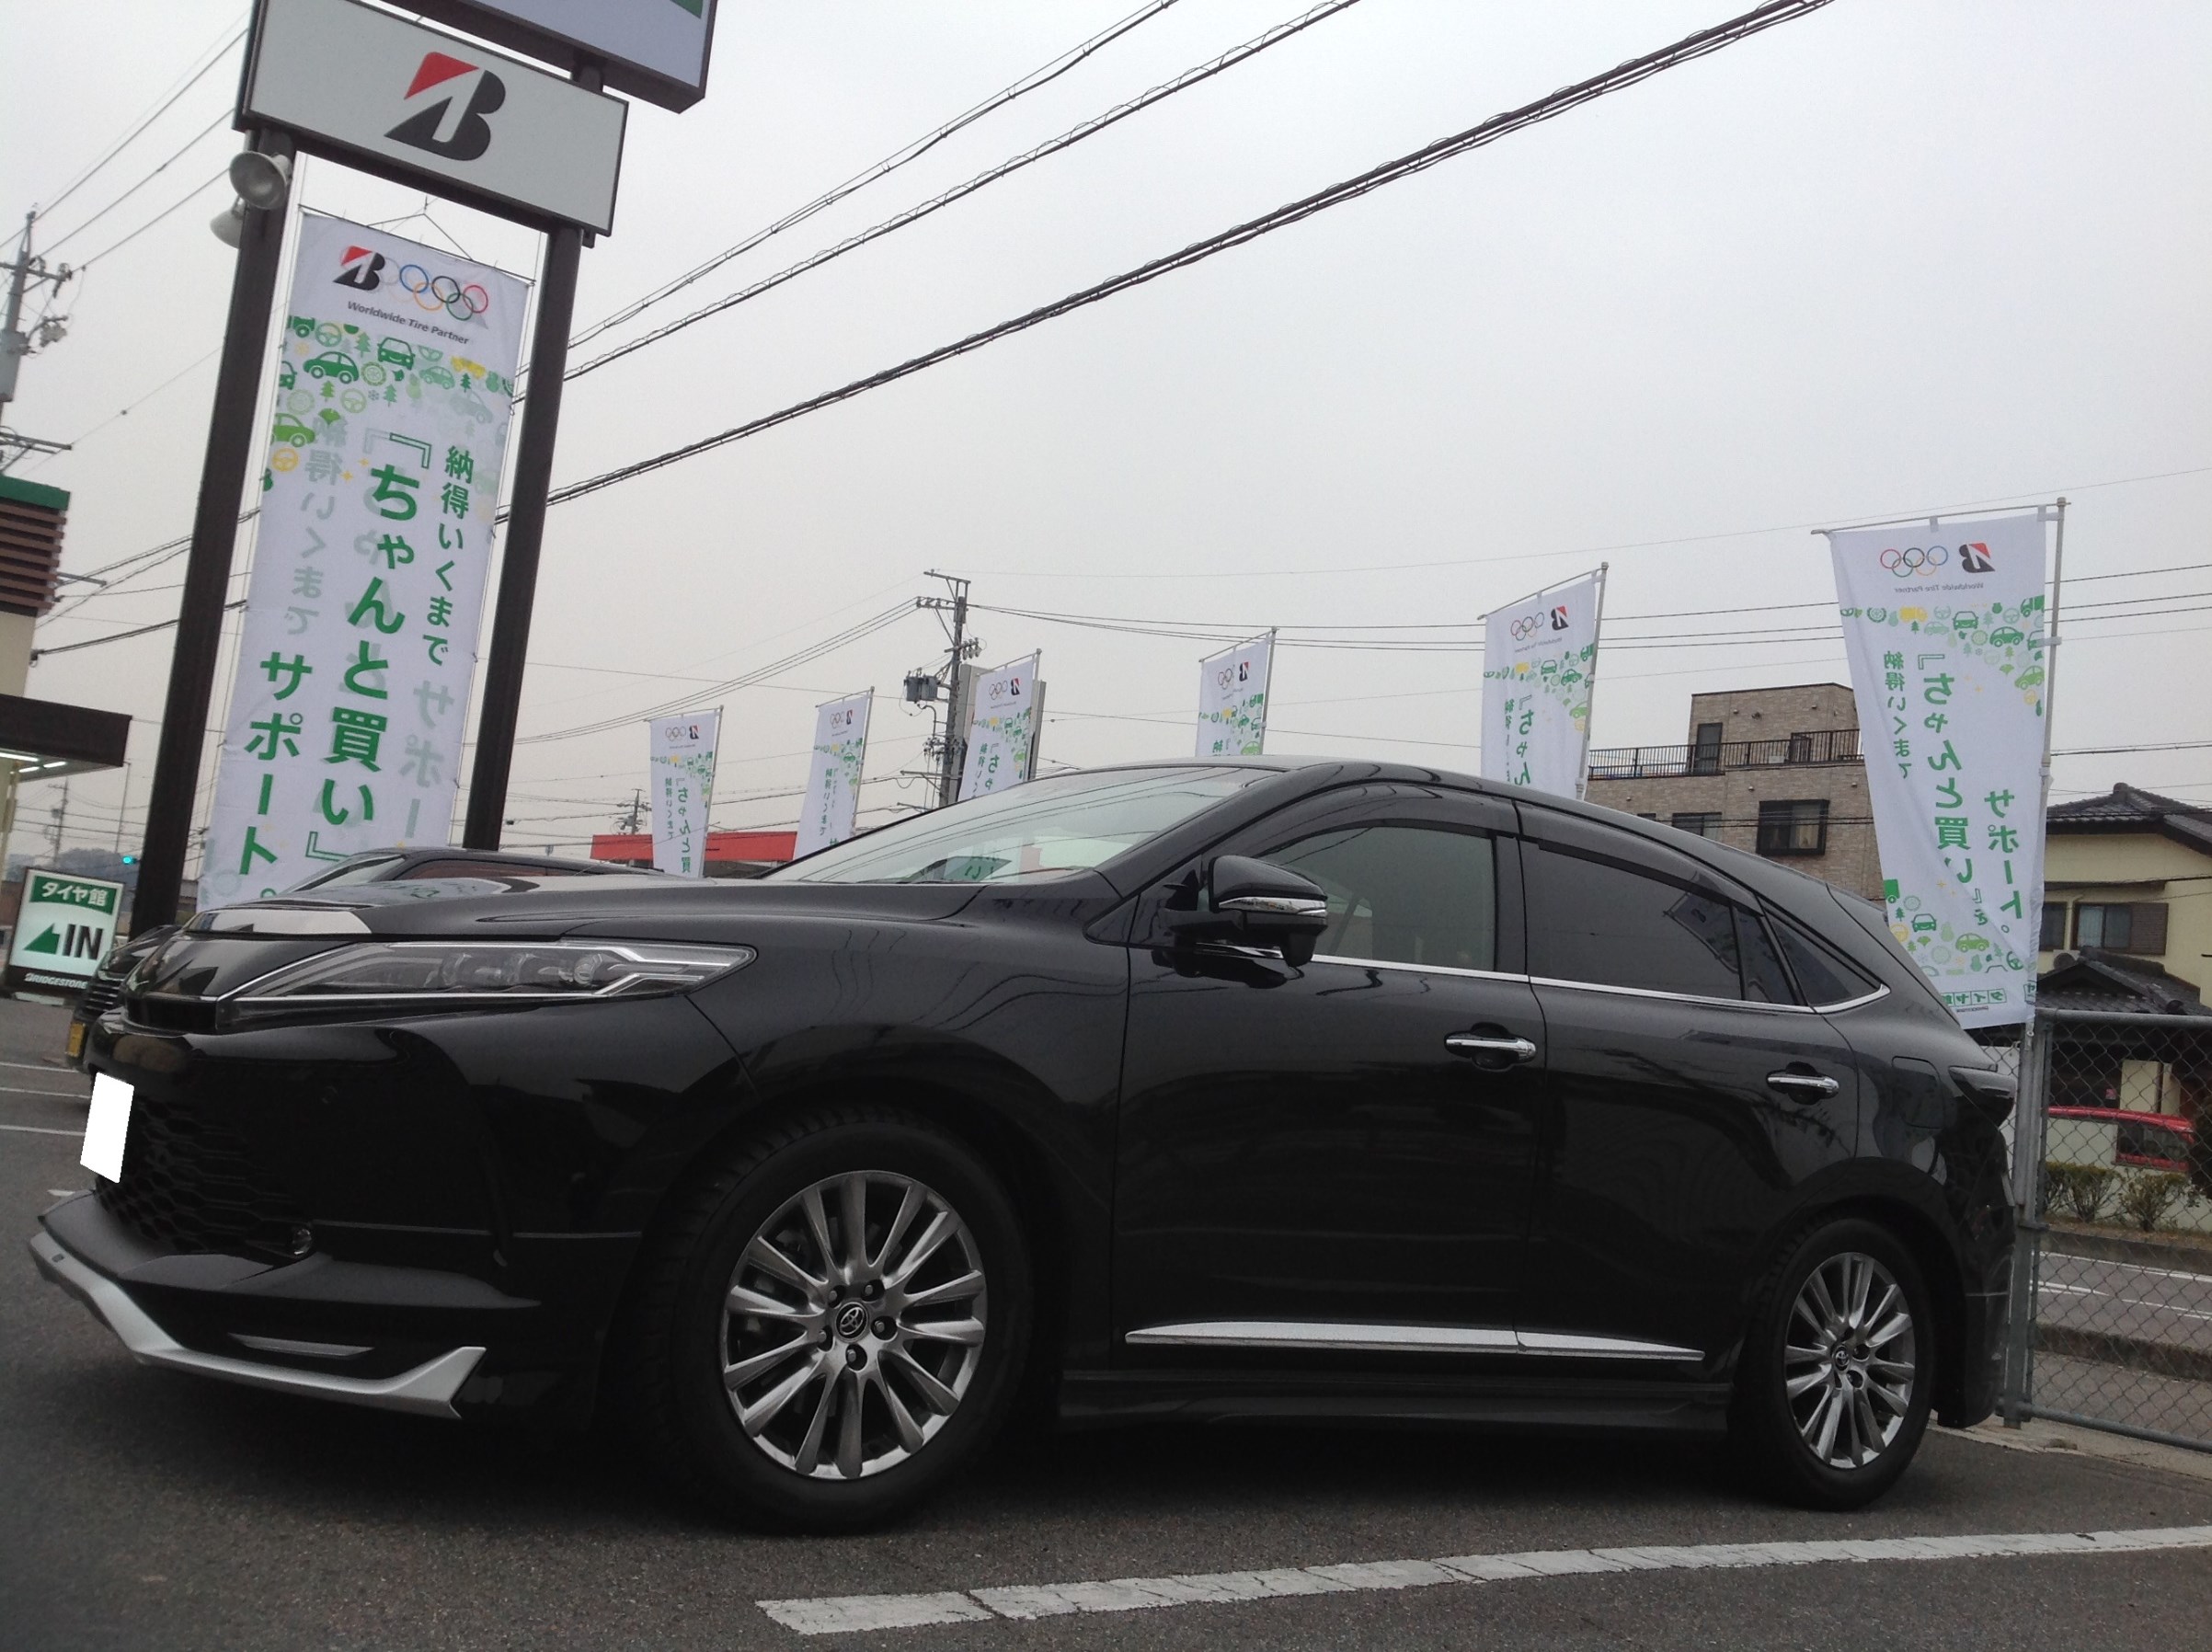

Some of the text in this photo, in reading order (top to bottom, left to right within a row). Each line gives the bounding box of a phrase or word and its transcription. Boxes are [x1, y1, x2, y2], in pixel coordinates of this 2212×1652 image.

[348, 301, 469, 345] Worldwide Tire Partner
[423, 445, 474, 666] 納得いくまで
[41, 881, 109, 907] タイヤ館
[62, 924, 104, 960] IN
[24, 972, 88, 989] BRIDGESTONE
